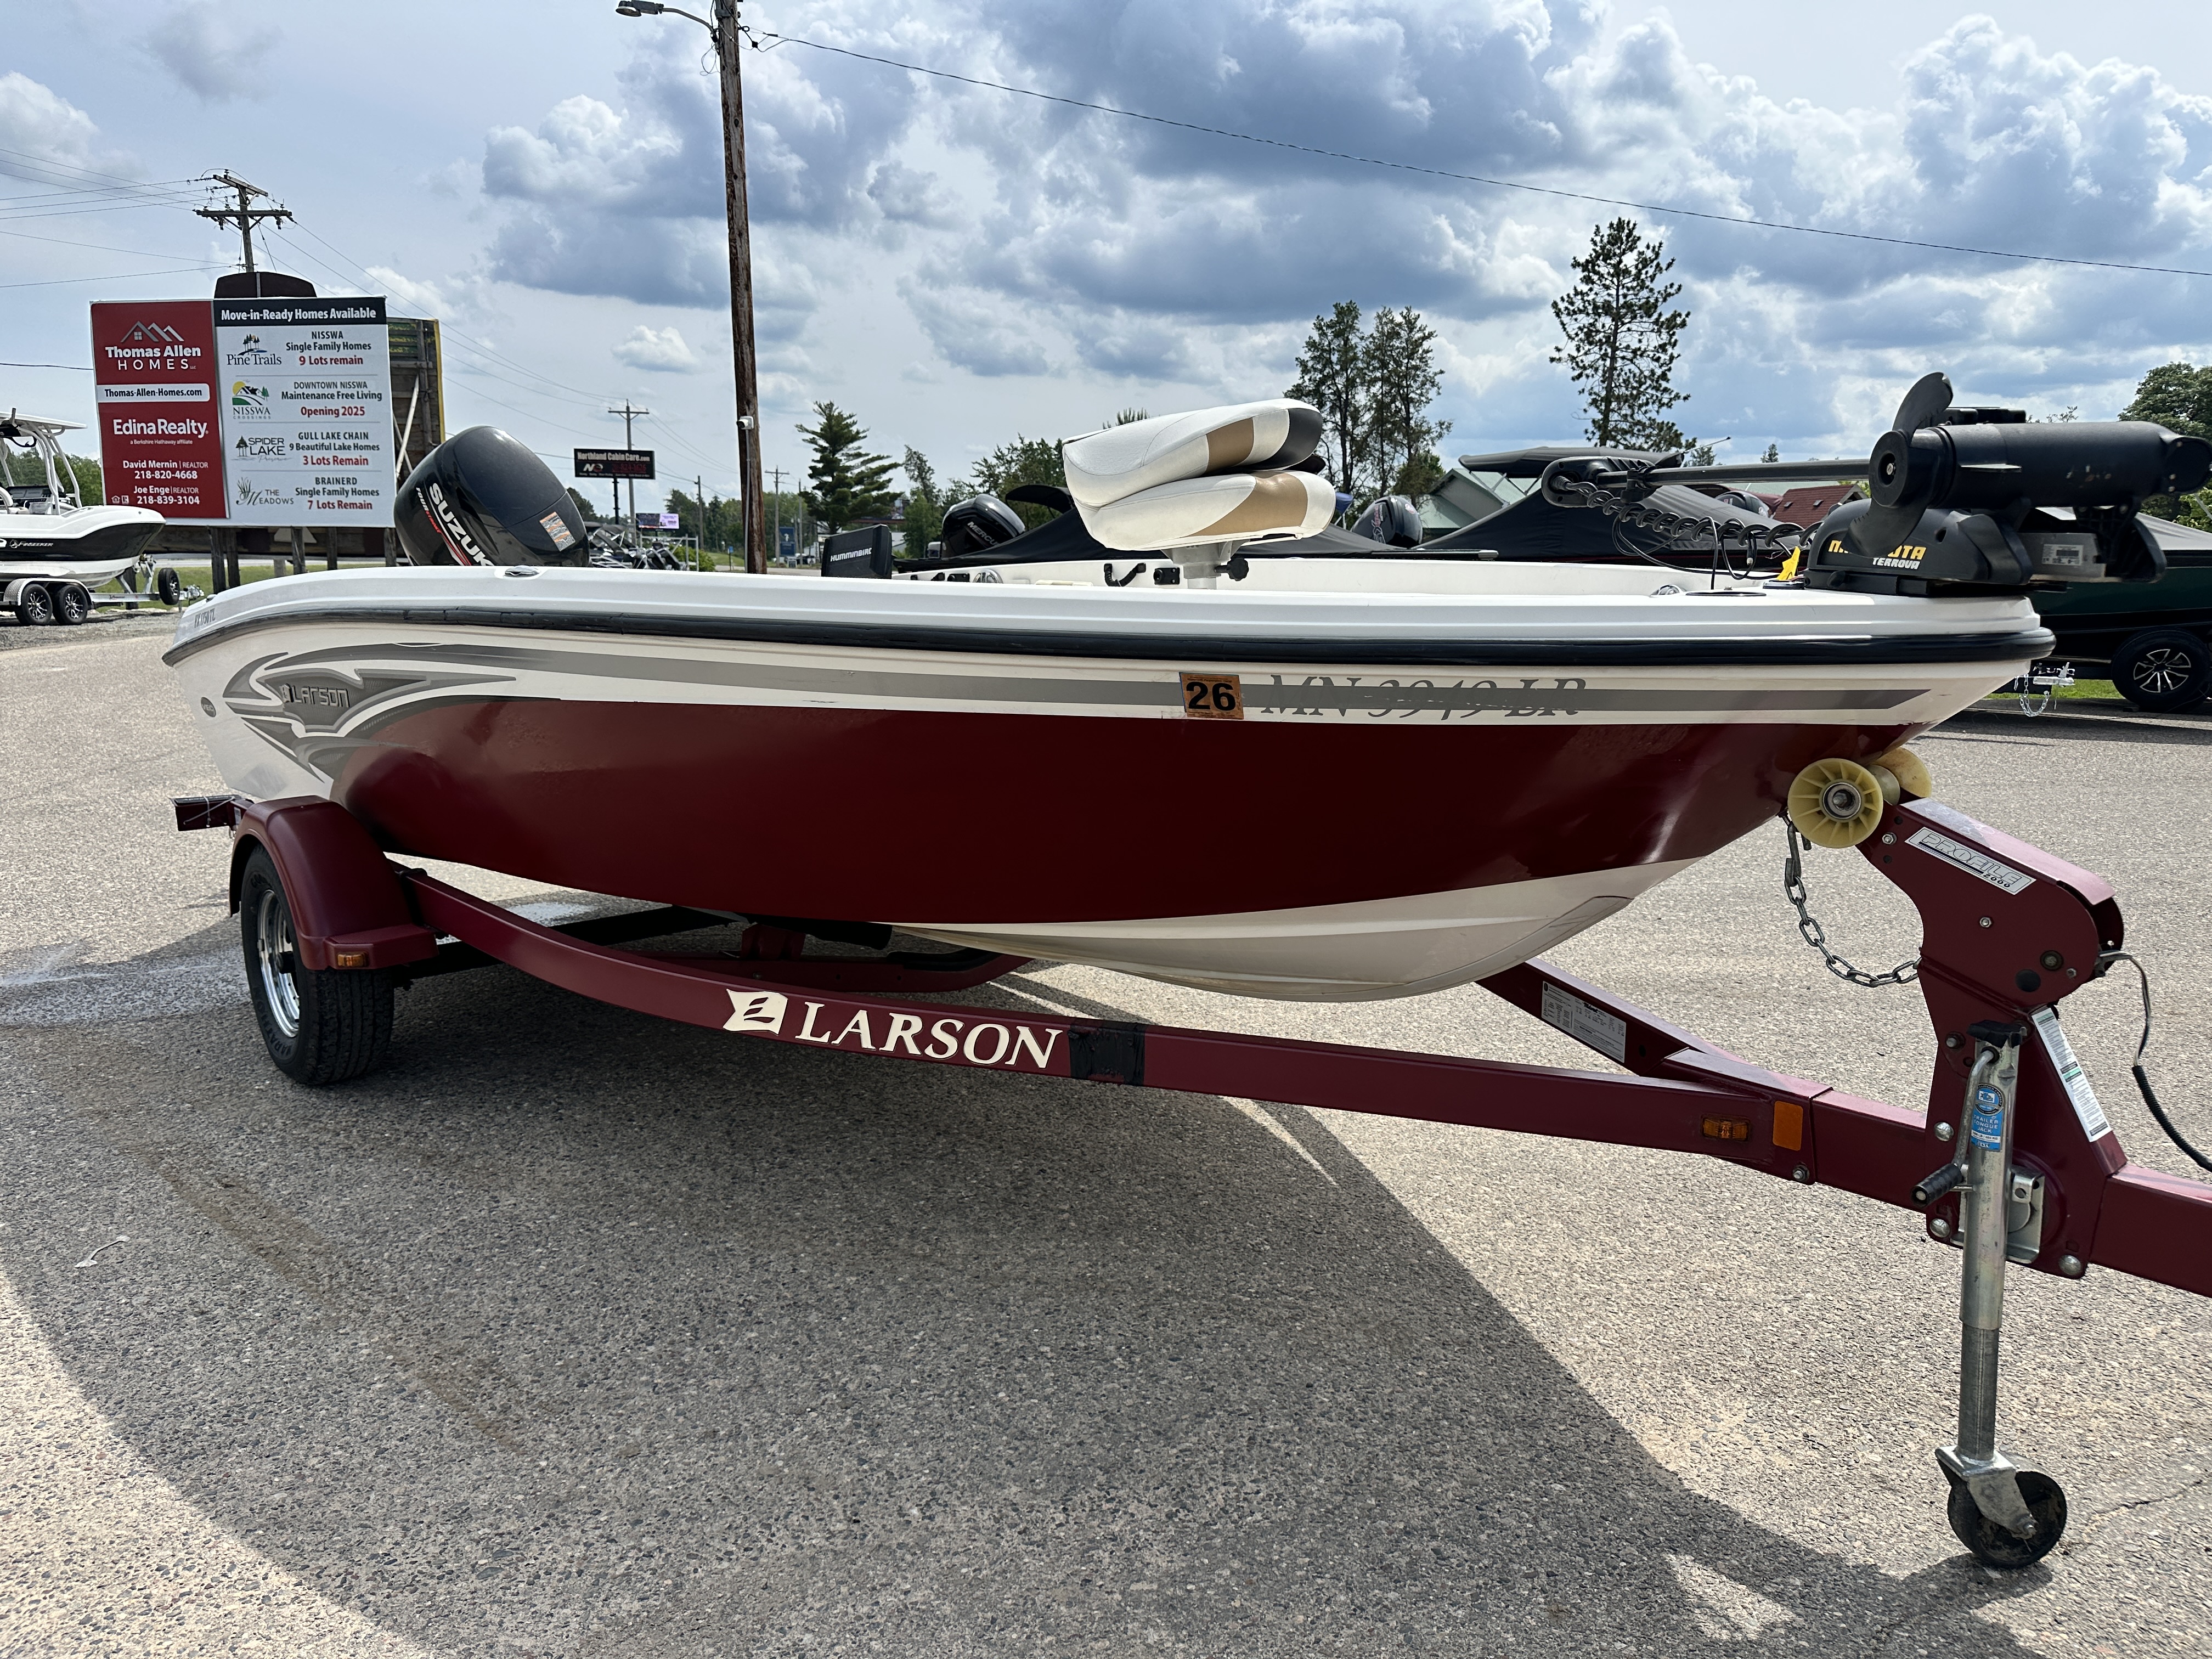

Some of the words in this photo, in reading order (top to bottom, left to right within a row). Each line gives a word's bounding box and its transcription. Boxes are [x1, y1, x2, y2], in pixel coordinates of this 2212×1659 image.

[221, 308, 294, 322] Move-in-Ready
[295, 308, 328, 319] Homes
[329, 307, 376, 319] Available
[311, 331, 343, 340] NISSWA
[105, 346, 161, 358] Thomas
[163, 345, 201, 357] Allen
[286, 342, 312, 353] Single
[313, 342, 341, 352] Family
[342, 342, 371, 351] Homes
[117, 358, 188, 370] HOMES
[226, 354, 250, 366] Pine
[251, 354, 282, 365] Trails
[299, 356, 306, 365] 9
[308, 356, 328, 365] Lots
[330, 356, 363, 365] remain
[104, 388, 202, 397] Thomas-Allen-Homes.com
[281, 392, 335, 400] Maintenance
[337, 392, 355, 400] Free
[357, 391, 382, 402] Living
[233, 407, 270, 415] NISSWA
[301, 407, 340, 418] Opening
[341, 406, 365, 416] 2025
[321, 432, 341, 440] LAKE
[343, 432, 369, 440] CHAIN
[250, 446, 286, 455] LAKE
[295, 443, 332, 452] Beautiful
[334, 443, 352, 451] Lake
[353, 443, 380, 452] Homes
[303, 456, 309, 465] 3
[310, 456, 331, 465] Lots
[332, 456, 369, 465] Remain
[577, 452, 607, 460] Northland
[123, 460, 146, 469] David
[148, 460, 178, 469] Mernin
[134, 471, 198, 479] 218-820-4668
[133, 486, 148, 494] Joe
[149, 486, 170, 496] Enge
[295, 488, 321, 496] Single
[323, 488, 350, 497] Family
[352, 488, 380, 496] Homes
[137, 496, 200, 505] 218-839-3104
[307, 501, 313, 510] 7
[317, 501, 336, 510] Lots
[337, 501, 373, 510] Remain
[429, 483, 494, 566] SUZUK
[967, 521, 998, 545] MERCU
[1872, 557, 1921, 570] TERROVA
[1186, 681, 1235, 711] 26
[201, 703, 215, 712] VEC
[1921, 833, 2023, 885] PROFILE
[1983, 873, 2010, 888] 2000
[794, 1001, 1063, 1069] LARSON
[1973, 1114, 1999, 1124] TRAILER
[1973, 1120, 1998, 1129] TONGUE
